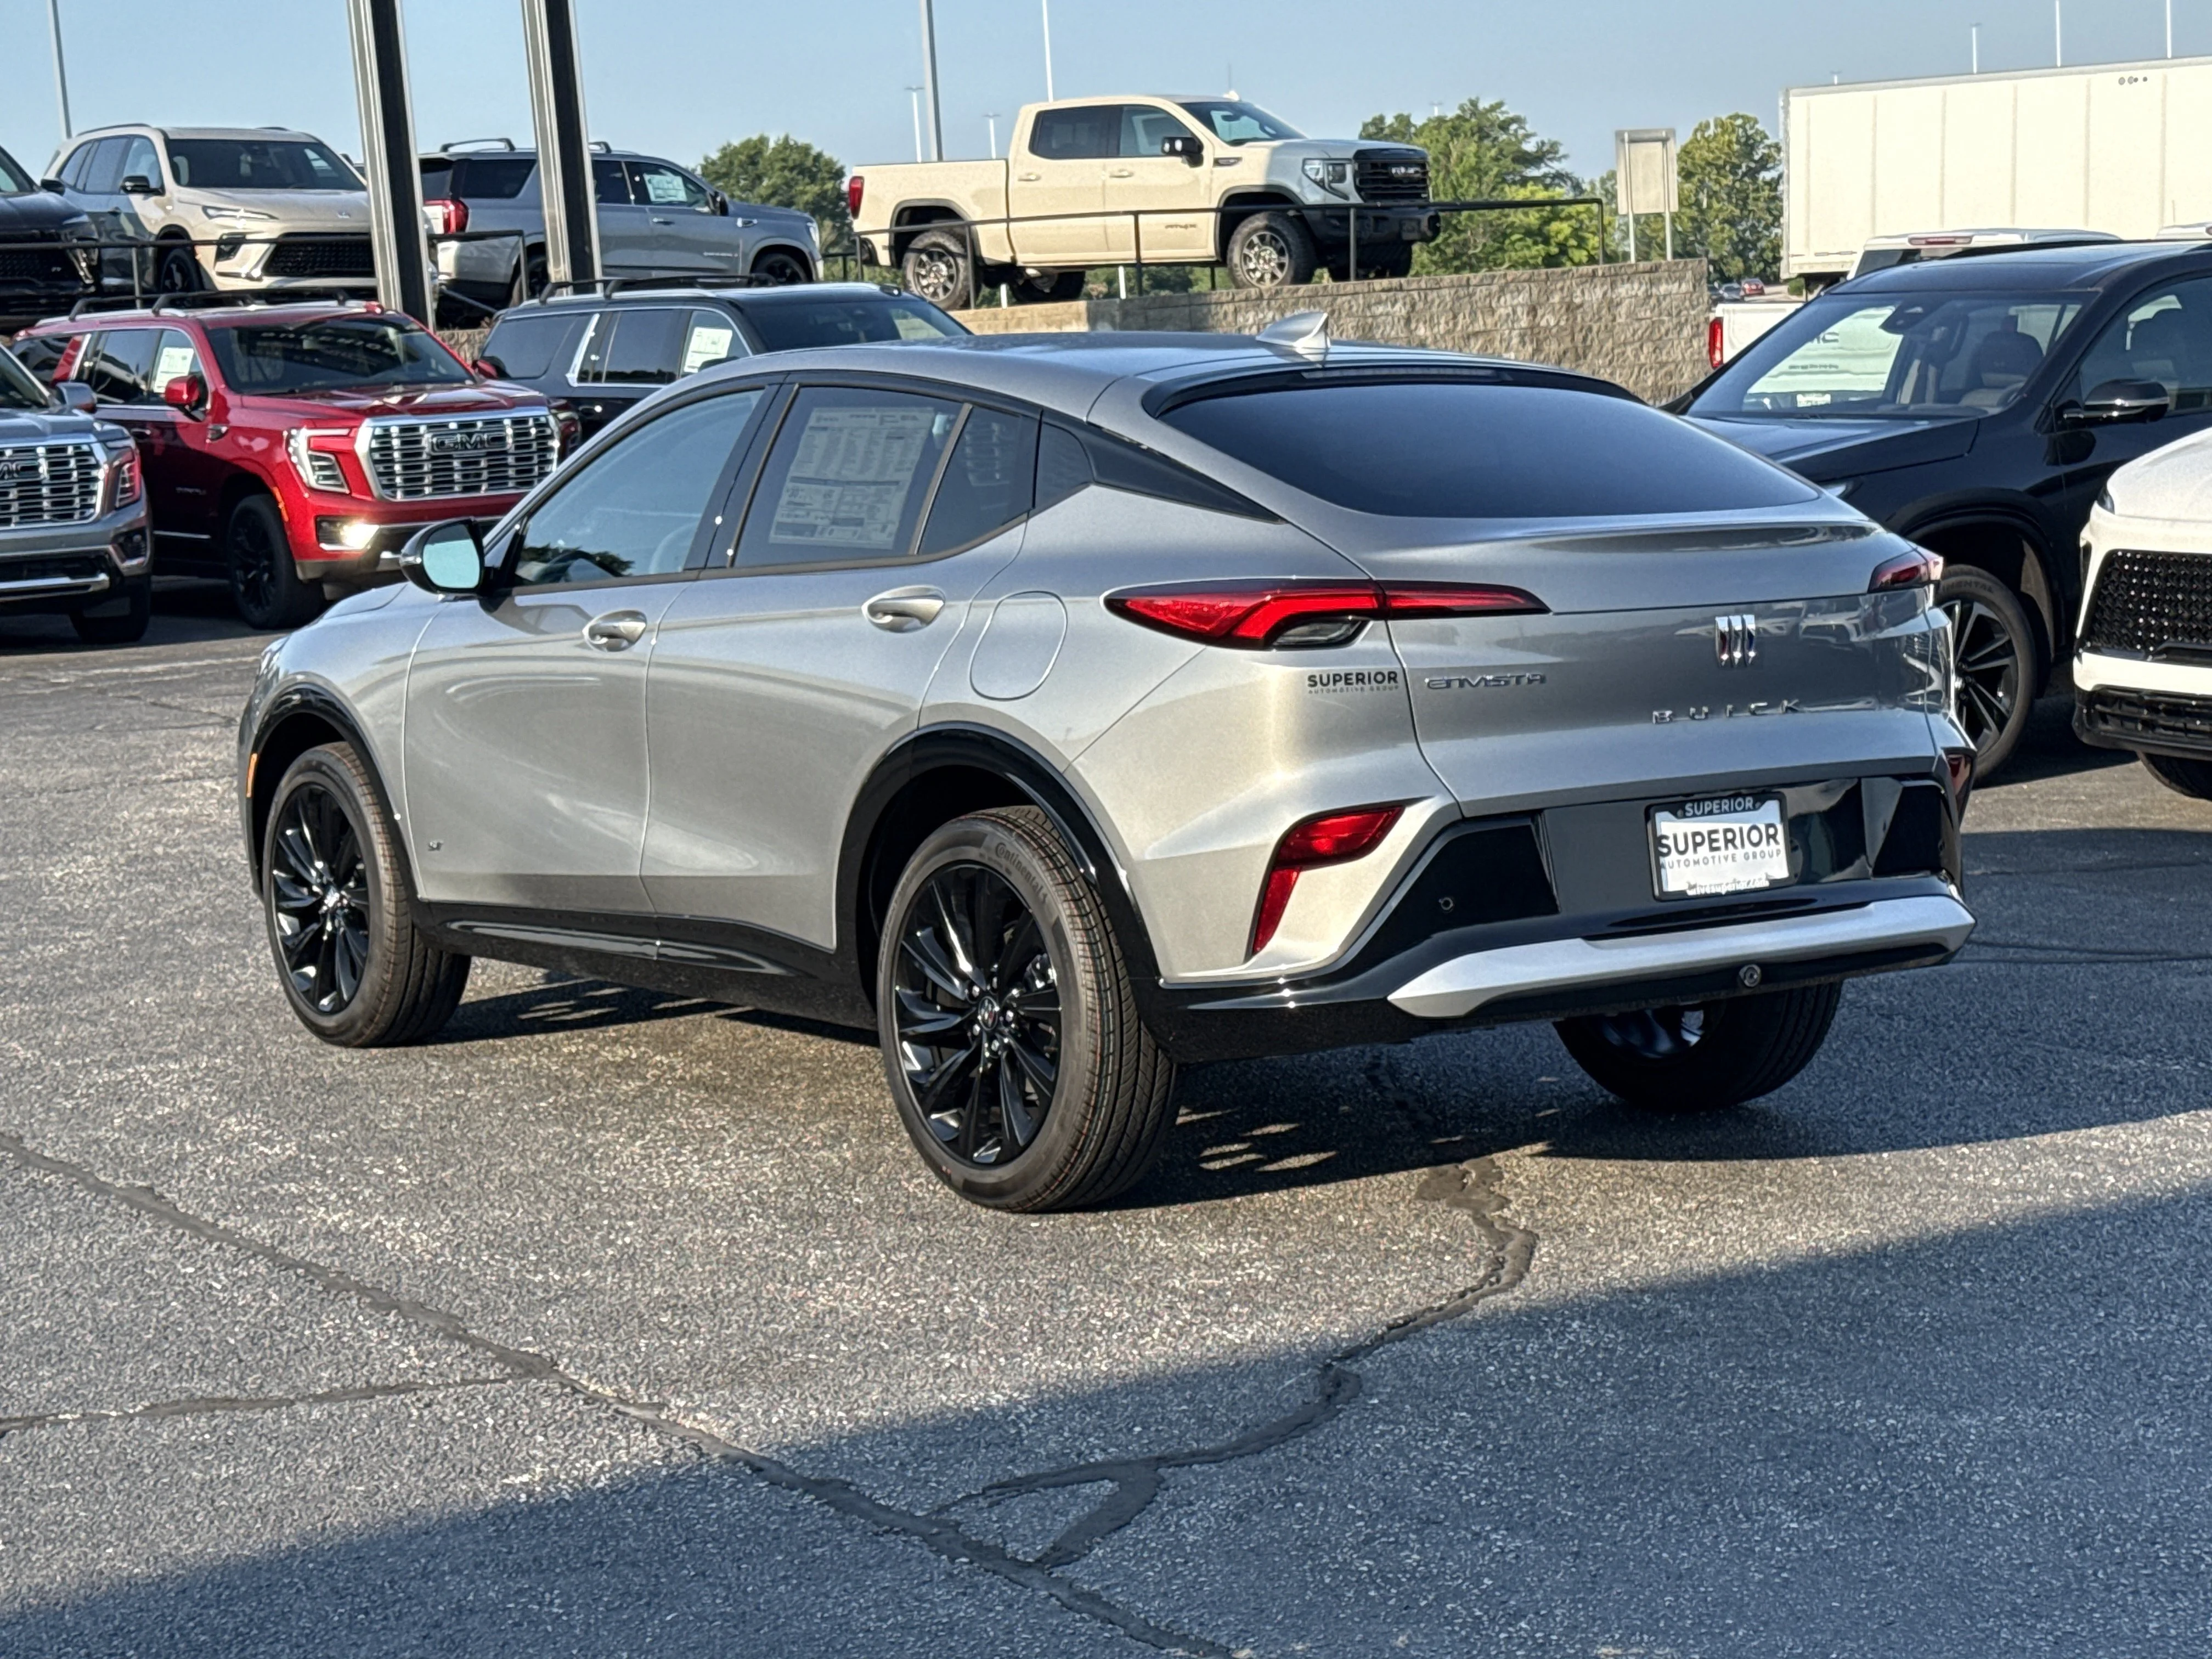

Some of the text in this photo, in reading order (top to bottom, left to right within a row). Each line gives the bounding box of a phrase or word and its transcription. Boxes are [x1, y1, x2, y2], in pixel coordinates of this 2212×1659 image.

[432, 433, 507, 452] GMC
[1307, 671, 1398, 687] SUPERIOR
[1425, 673, 1547, 690] ENVISTA
[1652, 699, 1800, 725] BUICK
[1685, 797, 1754, 816] SUPERIOR
[1657, 823, 1780, 857] SUPERIOR
[1661, 849, 1782, 870] AUTOMOTIVE GROUP
